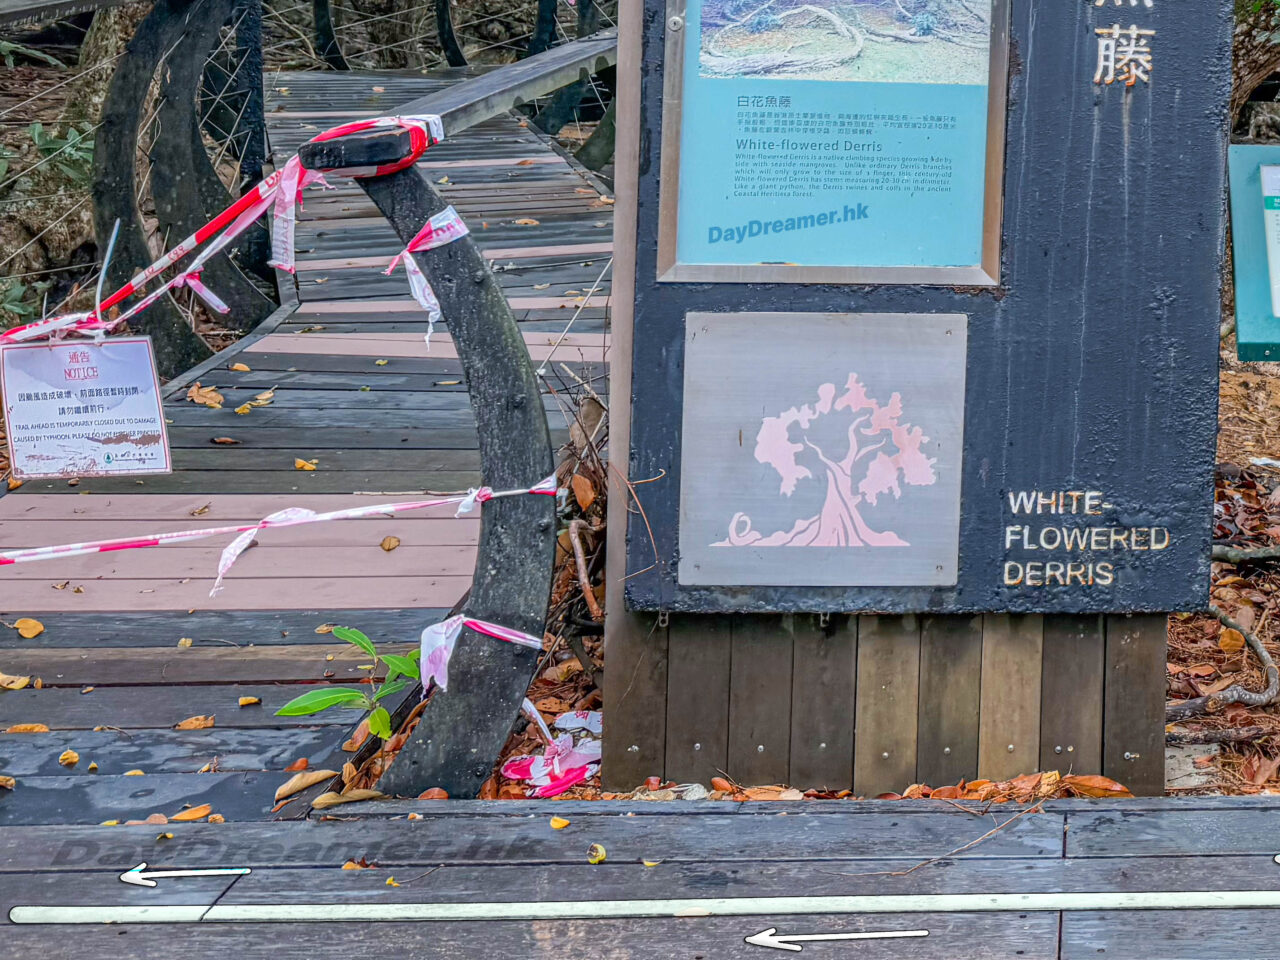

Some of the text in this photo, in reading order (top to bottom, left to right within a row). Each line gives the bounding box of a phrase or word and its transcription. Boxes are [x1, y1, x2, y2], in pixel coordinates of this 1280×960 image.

[737, 95, 791, 108] 白花魚藤
[735, 139, 882, 152] White-flowered Derris
[69, 351, 89, 364] 通告
[64, 366, 98, 379] NOTICE
[1008, 490, 1113, 515] WHITE-
[1005, 525, 1170, 551] FLOWERED
[1004, 560, 1114, 586] DERRIS
